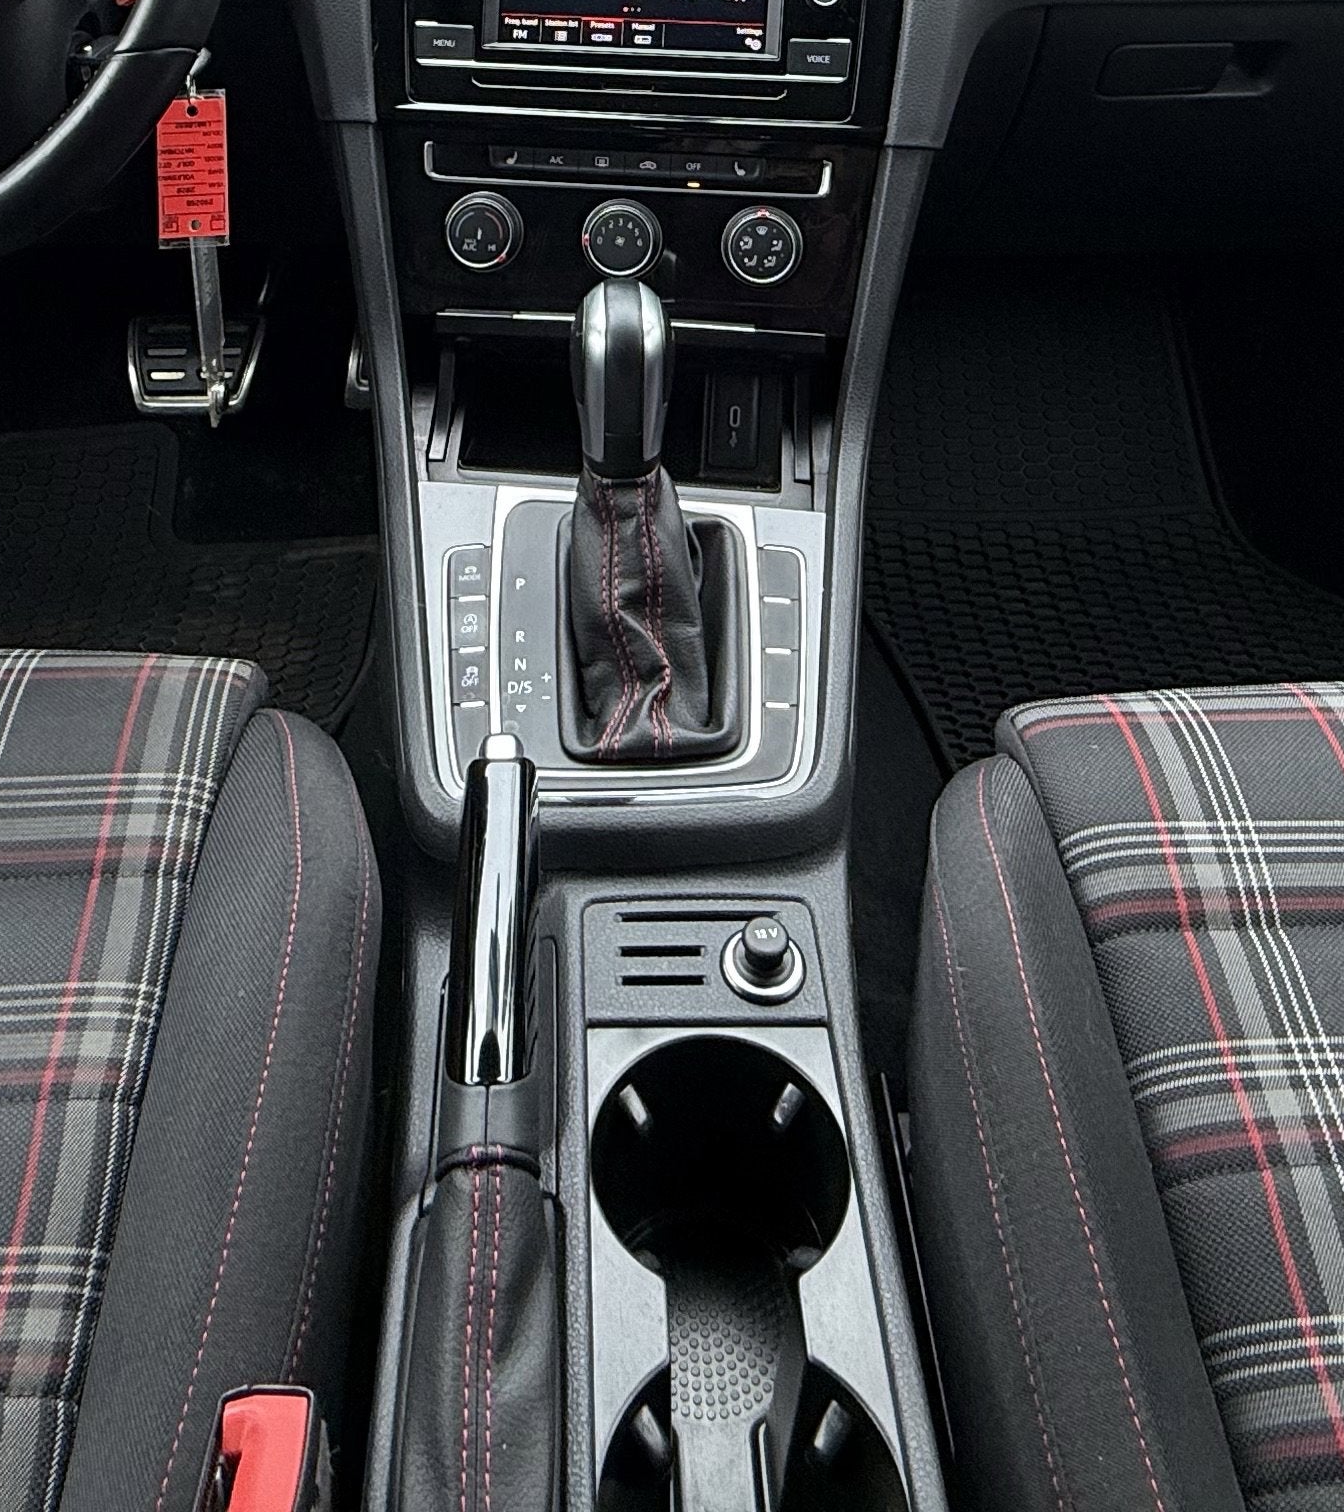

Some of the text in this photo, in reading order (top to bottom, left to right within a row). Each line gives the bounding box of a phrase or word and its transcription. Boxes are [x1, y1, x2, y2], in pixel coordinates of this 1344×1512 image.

[512, 29, 528, 40] FM
[432, 38, 456, 48] MENU
[806, 54, 831, 64] VOICE
[550, 156, 564, 165] A/C
[686, 162, 701, 170] OFF
[608, 220, 614, 228] 2
[618, 218, 624, 226] 3
[627, 222, 633, 230] 4
[601, 226, 606, 234] 1
[634, 228, 640, 236] 5
[596, 237, 603, 245] 0
[636, 238, 642, 246] 6
[488, 243, 496, 252] HI
[458, 574, 481, 582] MODE
[516, 578, 526, 590] P
[461, 624, 478, 634] OFF
[516, 630, 526, 642] R
[514, 658, 526, 671] N
[462, 678, 480, 687] OFF
[508, 680, 533, 694] D/S
